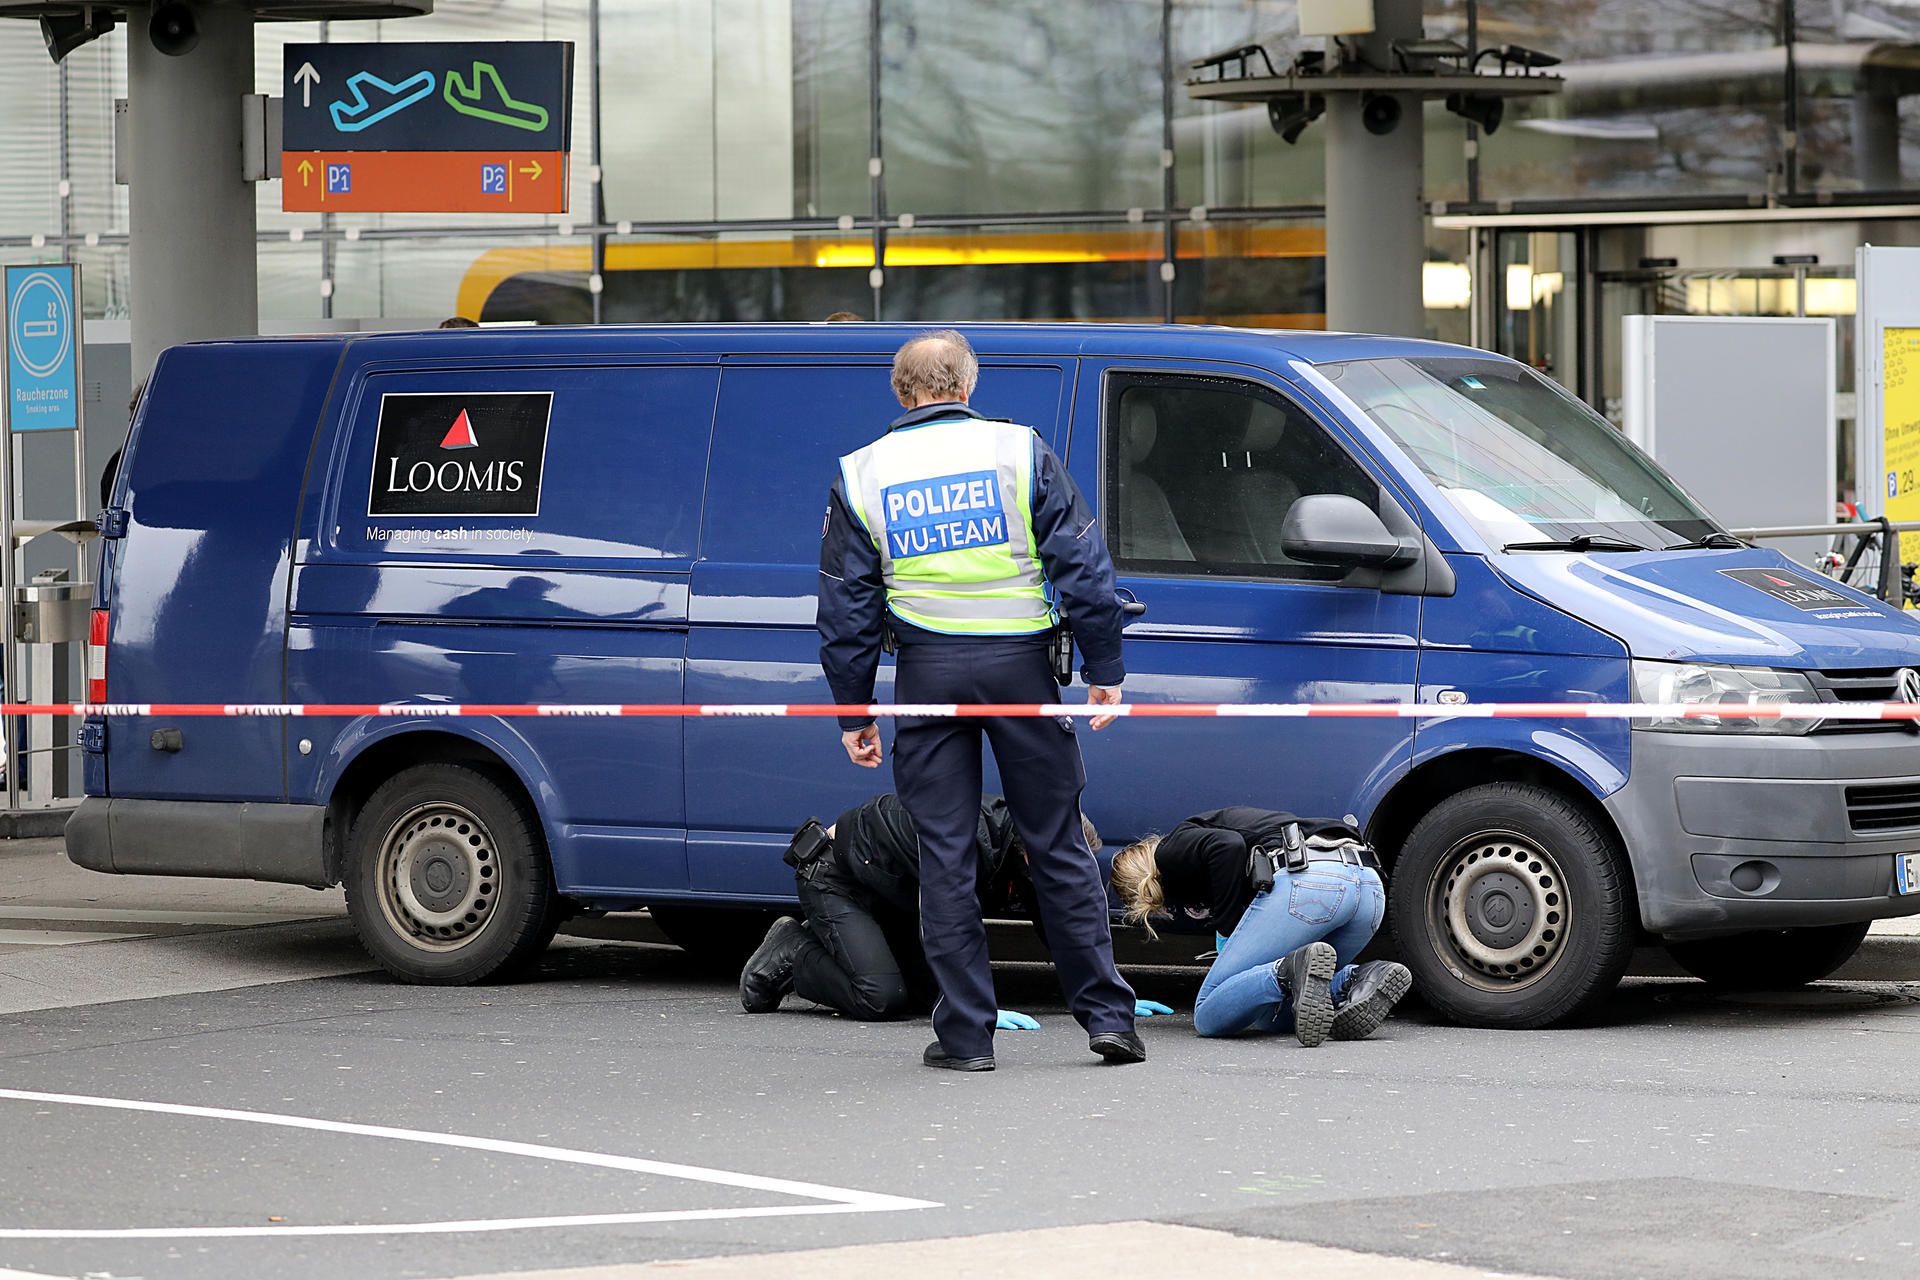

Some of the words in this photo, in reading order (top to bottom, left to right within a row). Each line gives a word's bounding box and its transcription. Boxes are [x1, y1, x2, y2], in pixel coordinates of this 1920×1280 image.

[16, 387, 69, 401] Raucherzone
[387, 456, 524, 493] LOOMIS
[887, 479, 995, 522] POLIZEI
[366, 526, 431, 543] Managing
[434, 526, 468, 541] cash
[471, 526, 483, 540] in
[486, 526, 536, 544] society.
[893, 516, 1003, 556] VU-TEAM
